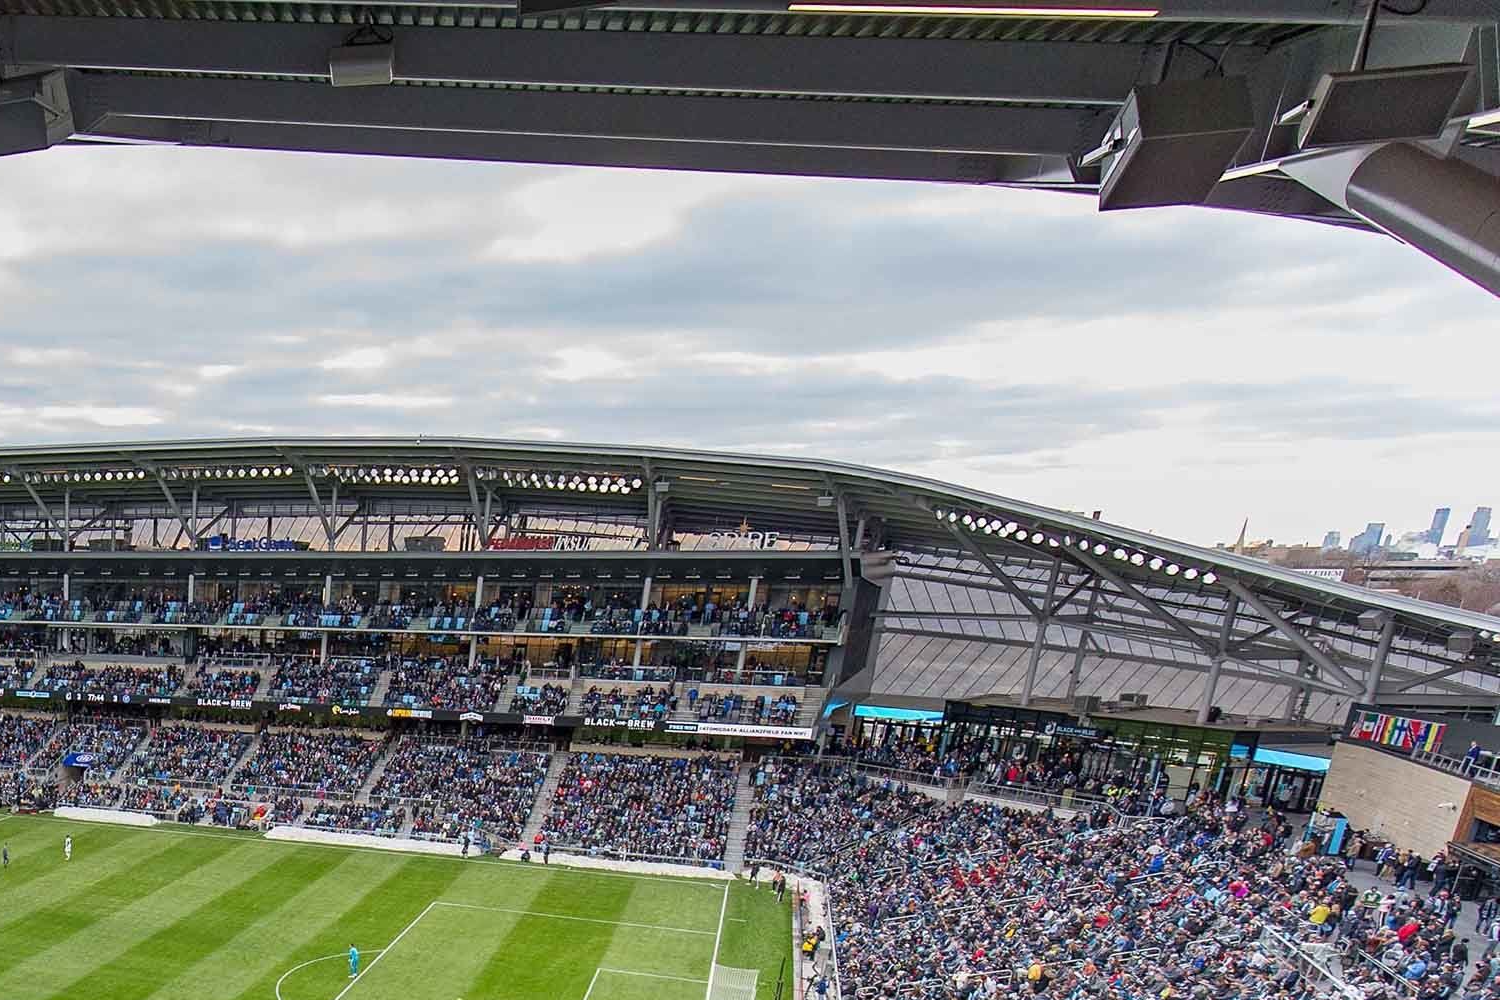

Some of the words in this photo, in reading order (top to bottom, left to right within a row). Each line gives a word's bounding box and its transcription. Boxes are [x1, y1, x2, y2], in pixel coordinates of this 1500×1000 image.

[197, 698, 222, 706] BLACK
[584, 718, 616, 727] BLACK
[627, 720, 656, 728] BREW
[1056, 726, 1074, 734] BLACK
